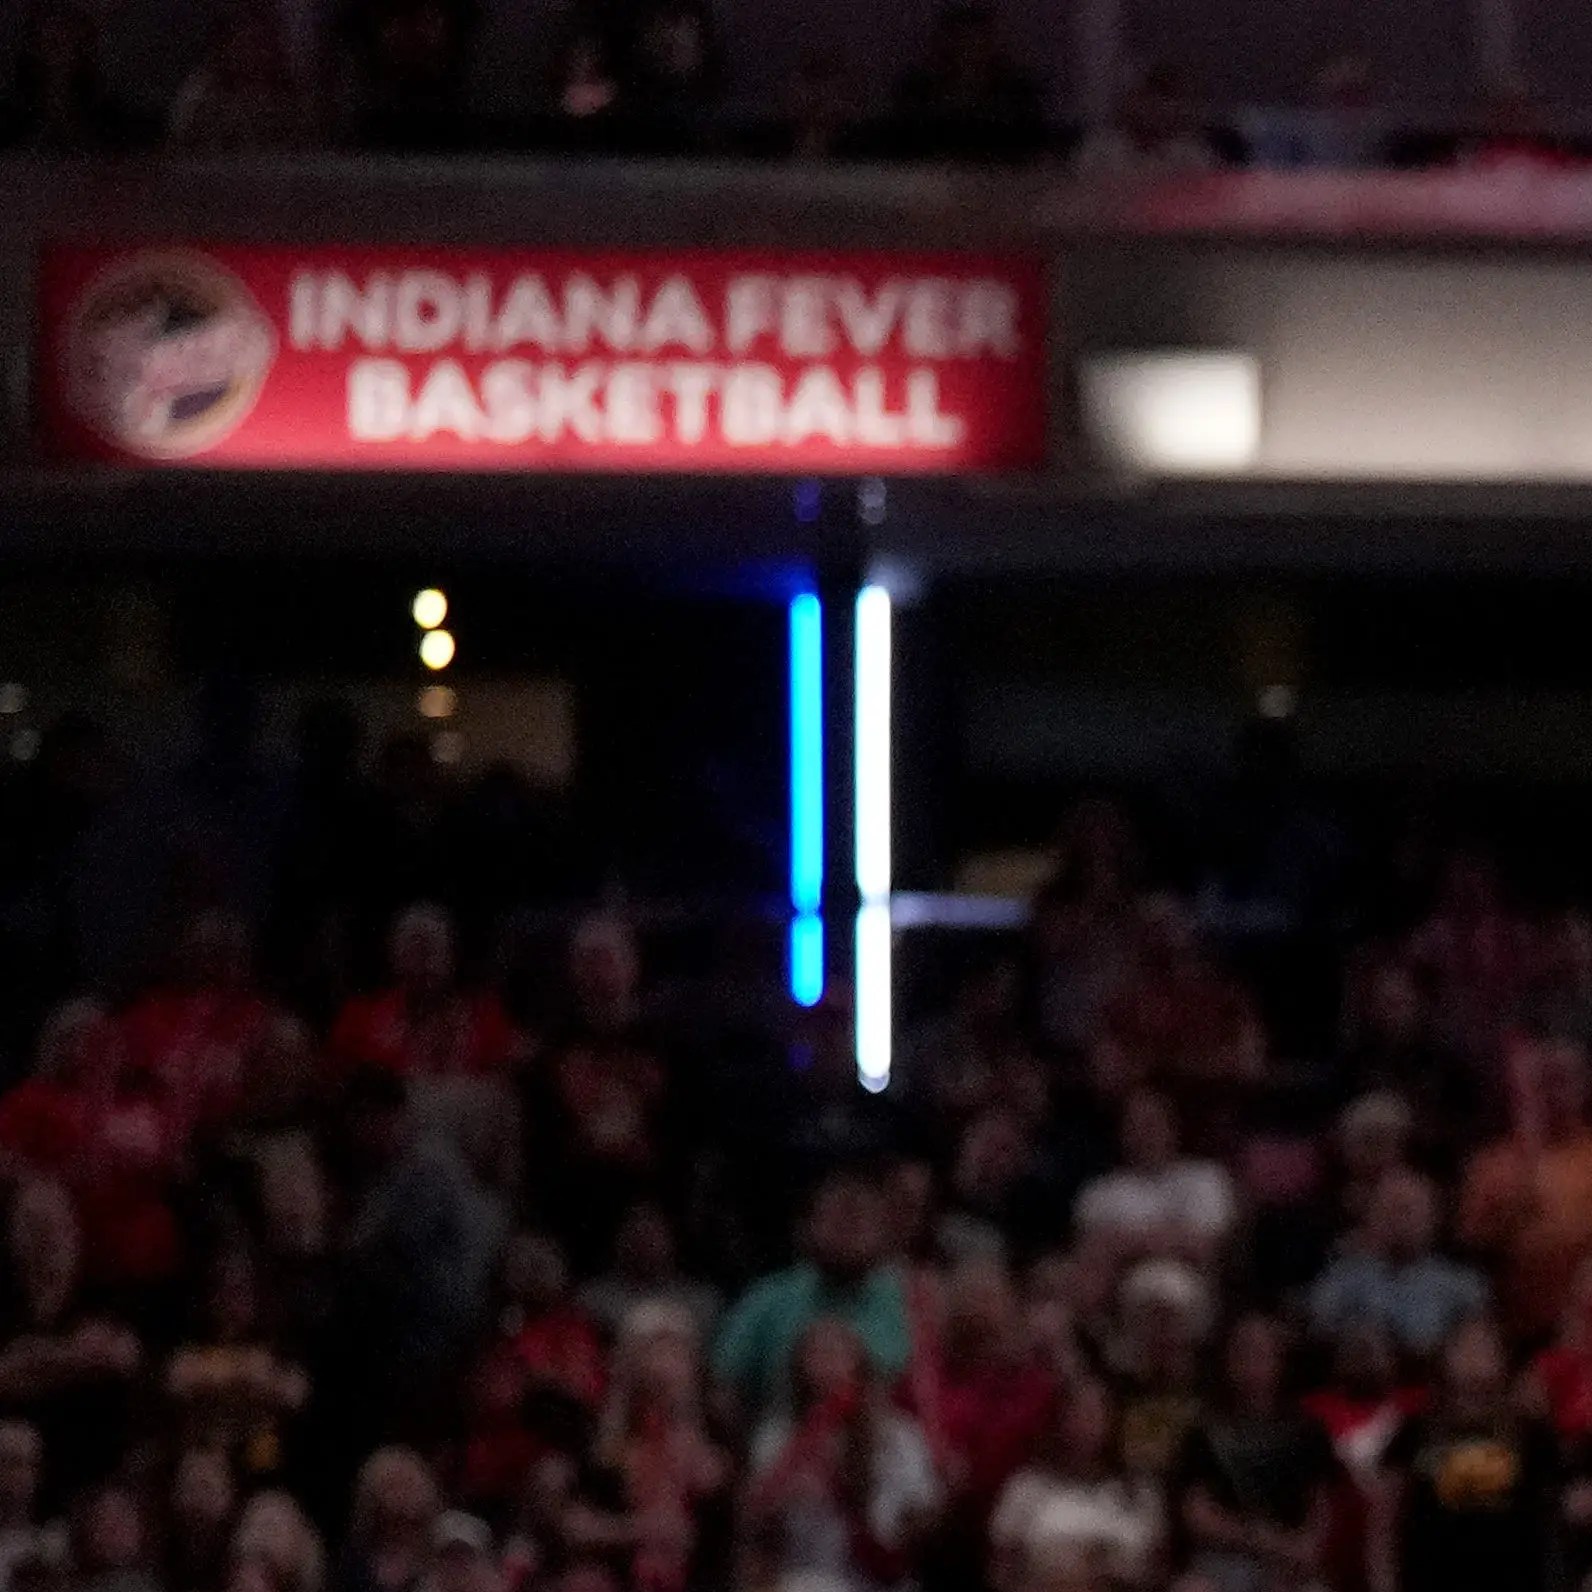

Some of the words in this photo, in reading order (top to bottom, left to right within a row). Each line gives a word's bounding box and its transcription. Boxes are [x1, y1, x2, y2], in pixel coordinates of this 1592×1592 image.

[287, 270, 709, 354] INDIANA
[726, 274, 1016, 361] FEVER
[347, 359, 963, 448] BASKETBALL
